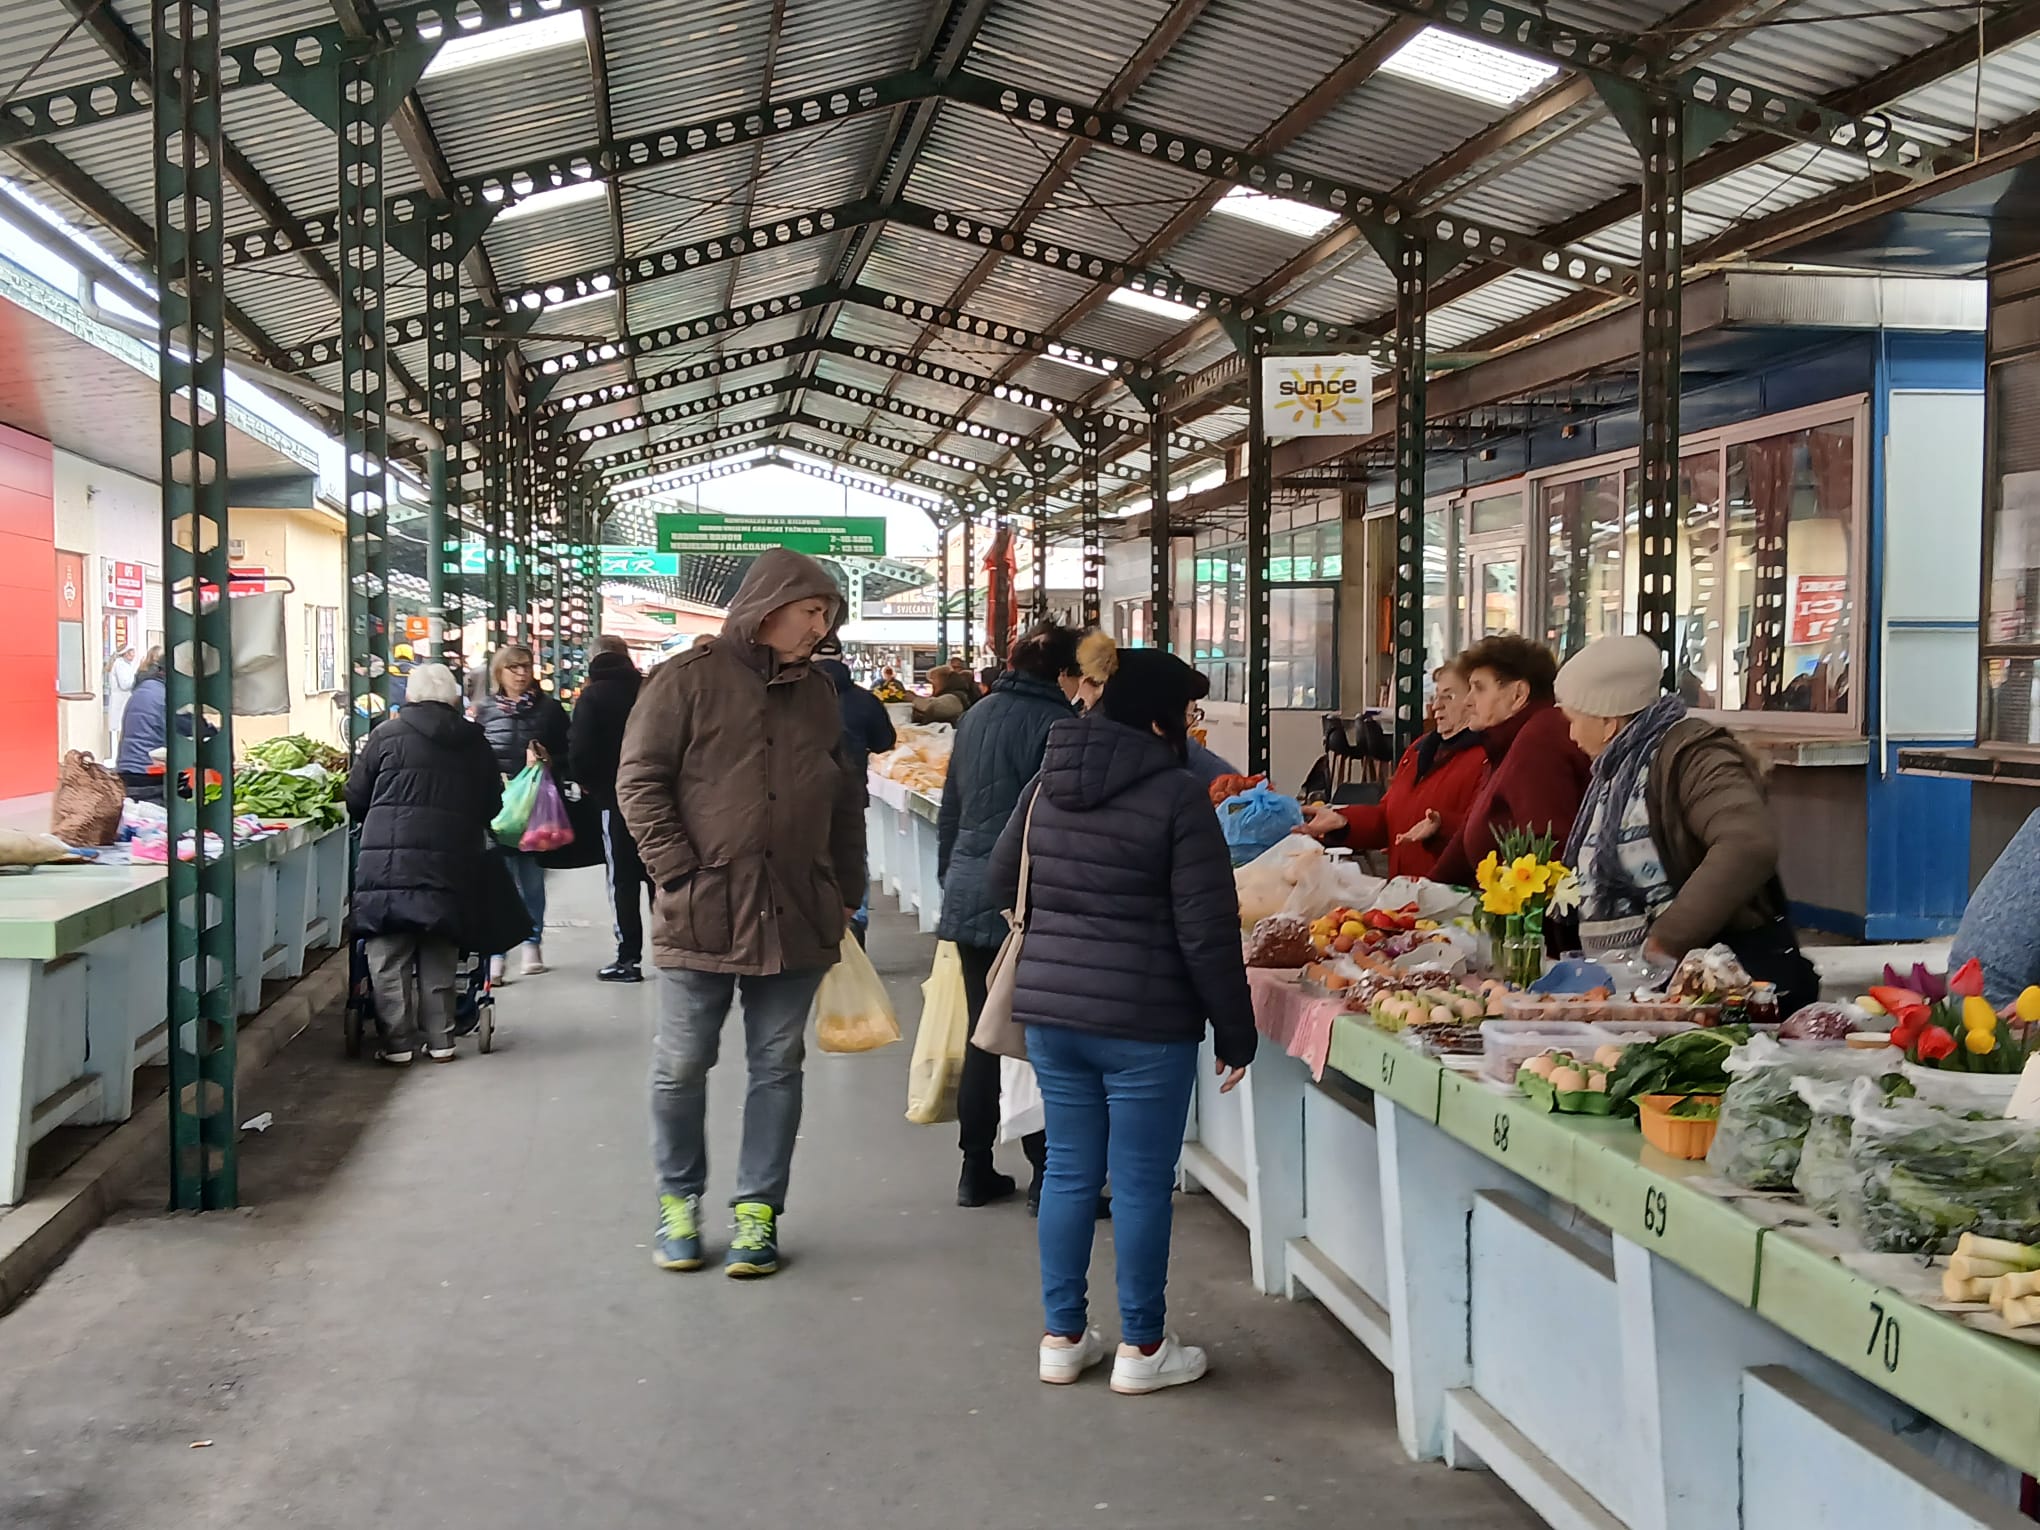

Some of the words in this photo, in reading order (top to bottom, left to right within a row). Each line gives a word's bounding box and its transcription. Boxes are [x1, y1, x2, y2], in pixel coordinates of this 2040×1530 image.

[1279, 379, 1357, 396] sunce
[1315, 398, 1322, 414] 1
[1493, 1113, 1510, 1152] 68
[1644, 1185, 1667, 1238] 69
[1866, 1301, 1901, 1373] 70
